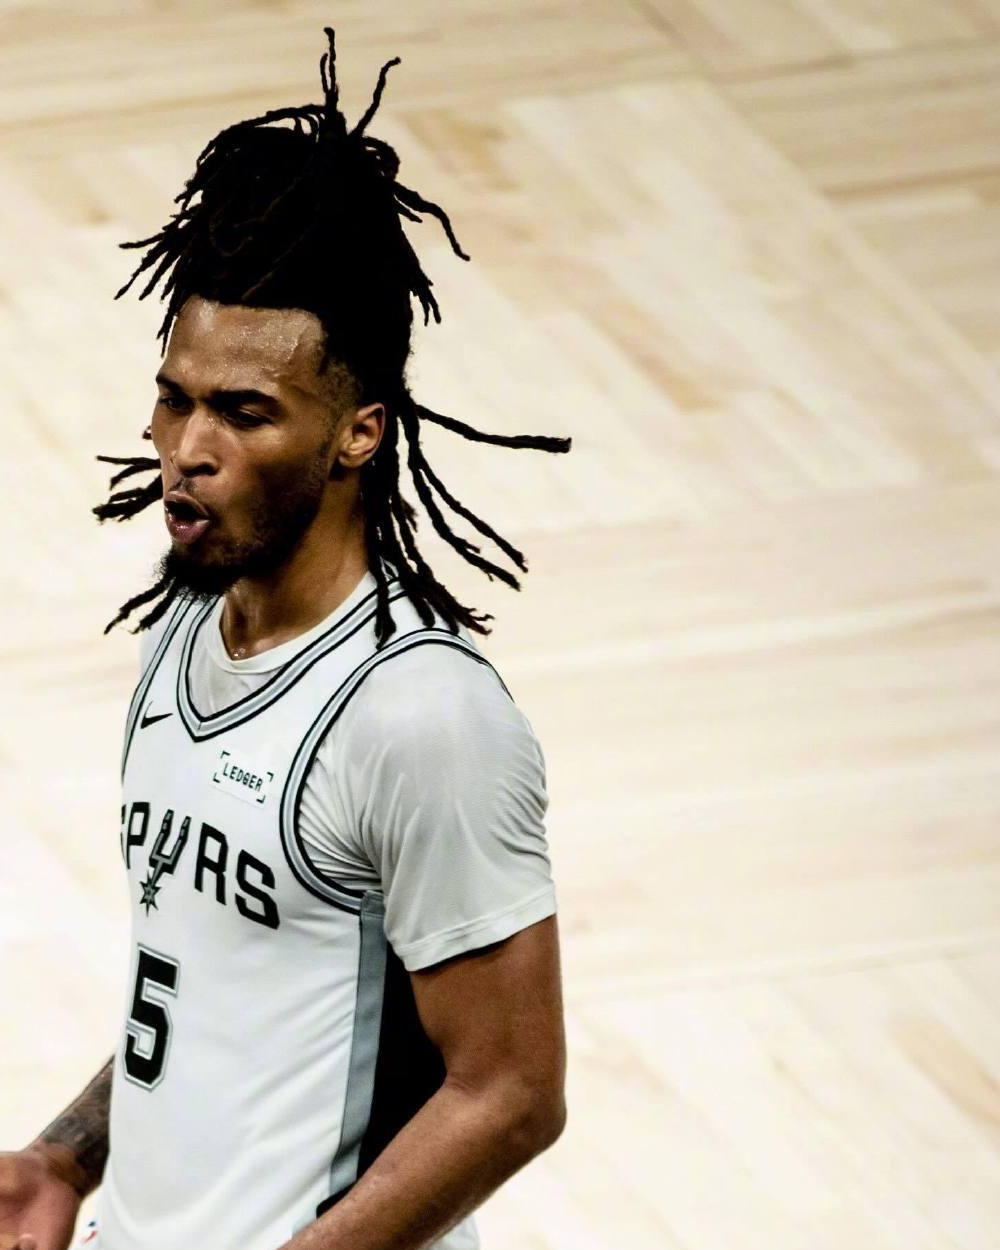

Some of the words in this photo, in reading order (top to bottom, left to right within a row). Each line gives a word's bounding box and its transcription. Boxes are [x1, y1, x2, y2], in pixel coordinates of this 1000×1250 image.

[222, 763, 263, 792] LEDGER
[120, 801, 281, 930] PURS
[122, 942, 181, 1093] 5
